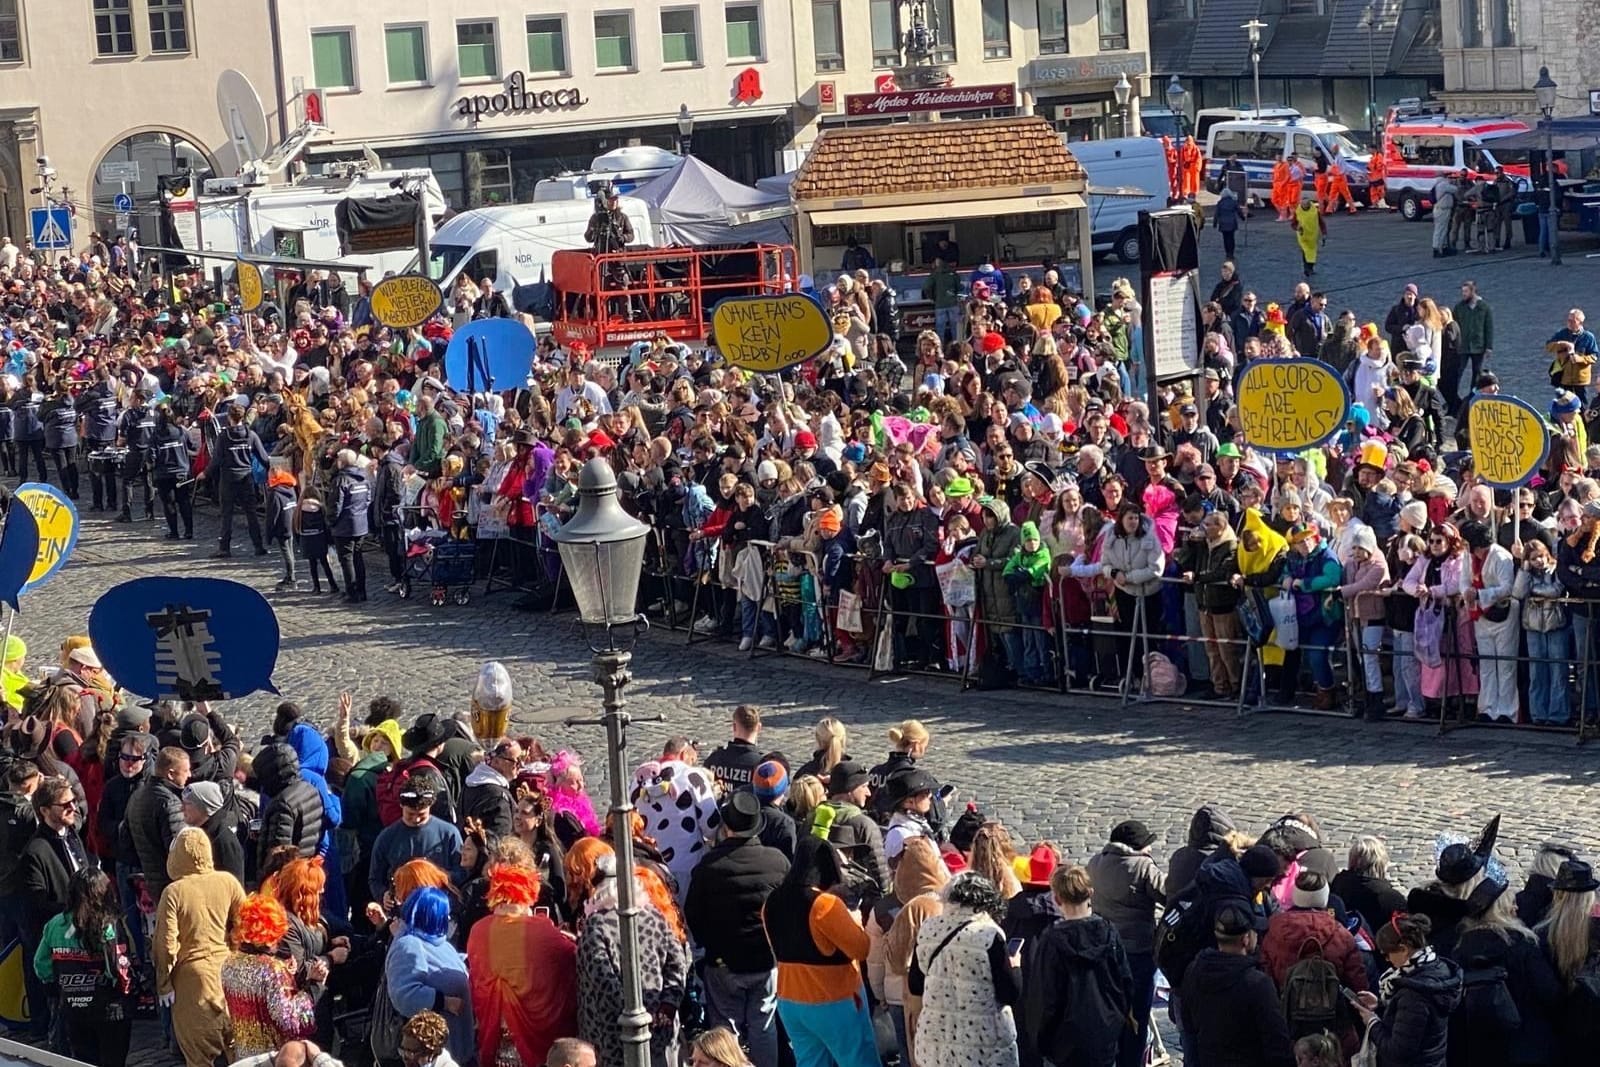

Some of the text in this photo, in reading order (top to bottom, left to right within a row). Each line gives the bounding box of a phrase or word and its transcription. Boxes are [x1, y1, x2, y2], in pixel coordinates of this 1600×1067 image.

[456, 70, 589, 123] apotheca
[867, 89, 993, 112] Modes Heideschinken
[515, 252, 532, 264] NDR
[400, 278, 437, 296] BLEIBEN
[720, 301, 806, 325] OHNE FANS
[740, 321, 780, 344] KEIN
[1246, 365, 1325, 395] ALL COPS
[1263, 391, 1296, 415] ARE
[1243, 406, 1339, 443] BEHRENS!
[1474, 402, 1529, 434] DANIELA
[710, 765, 752, 783] POLIZEI
